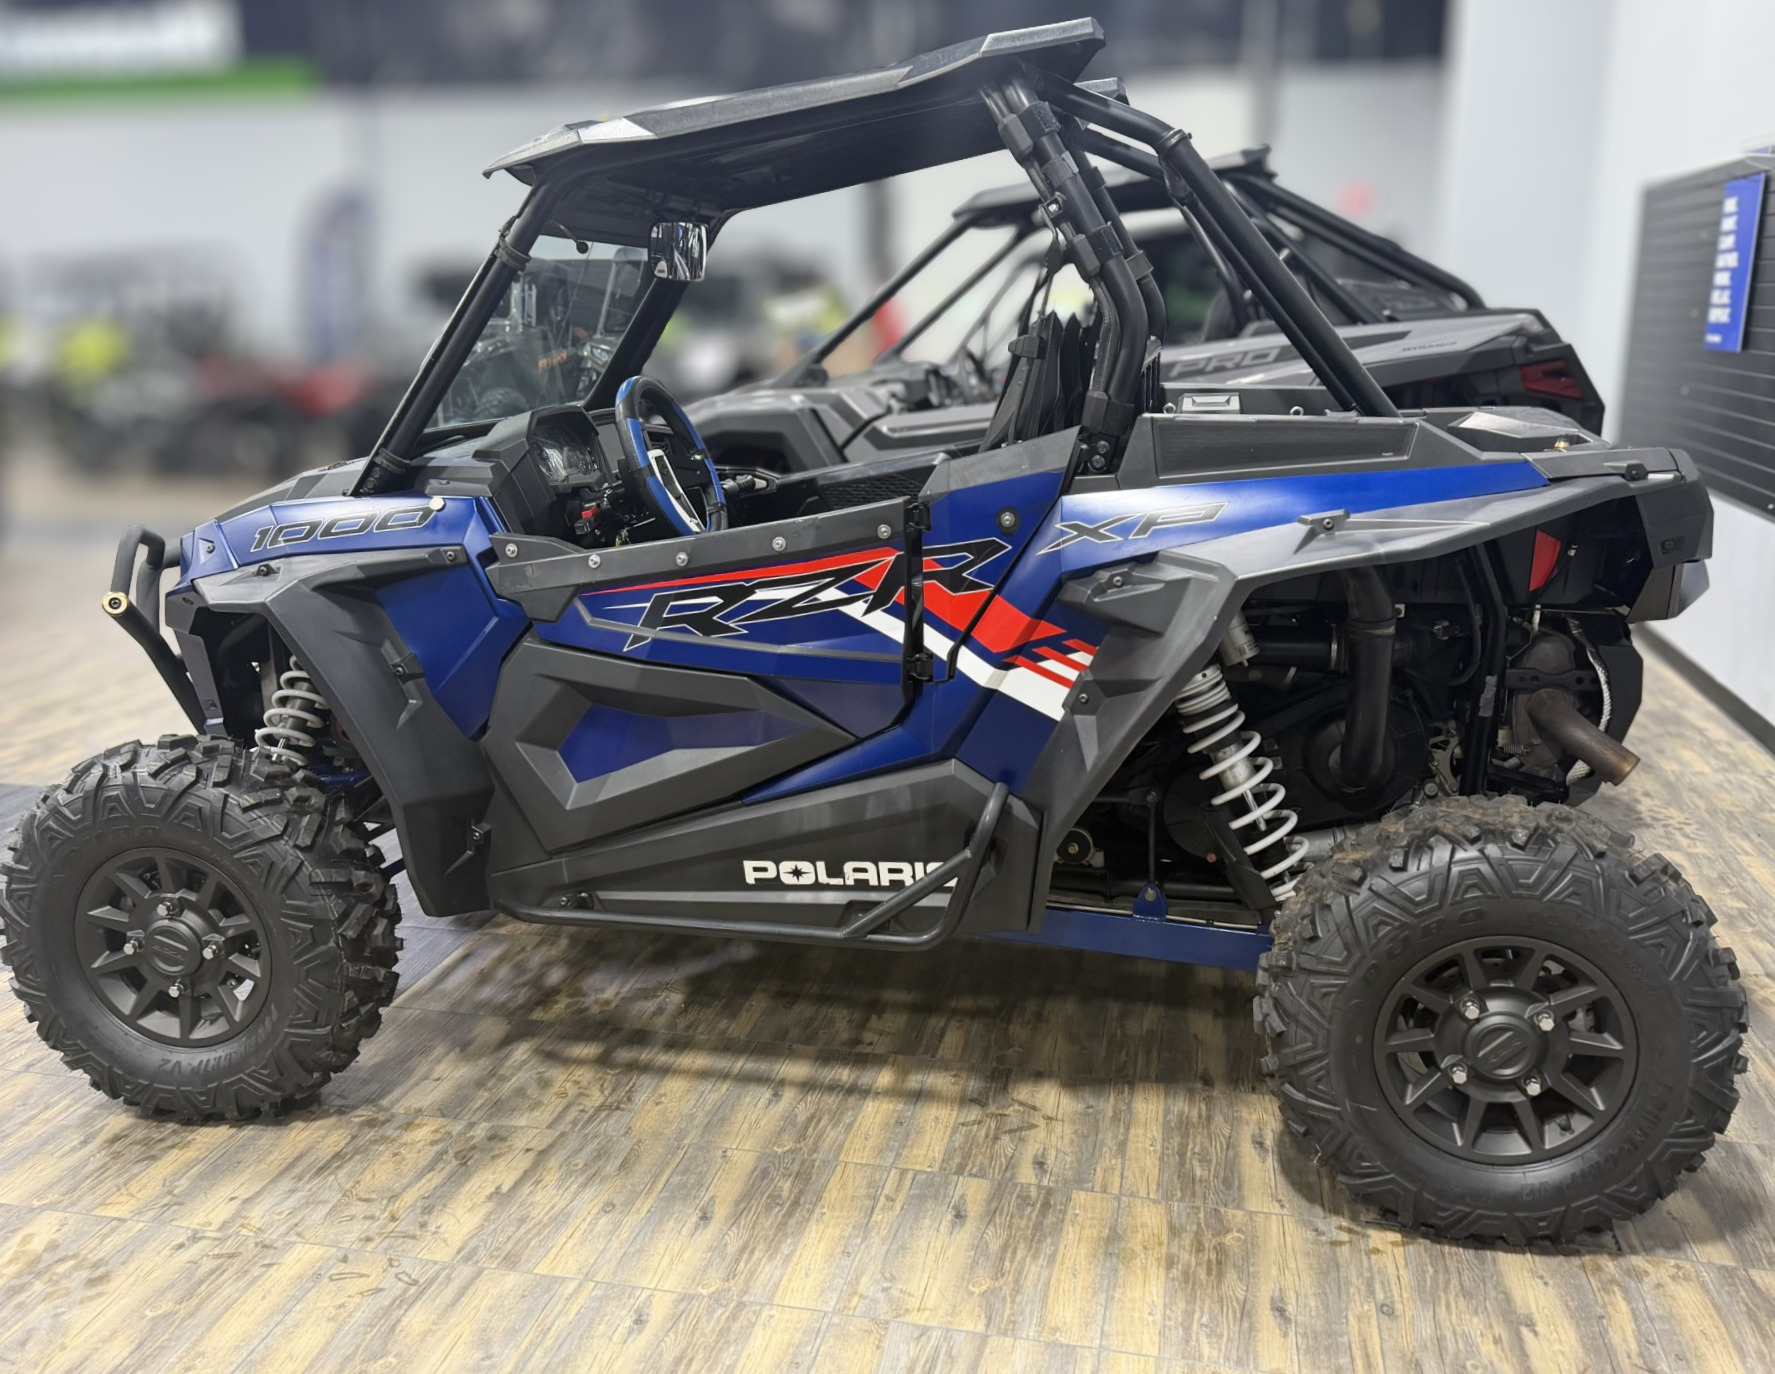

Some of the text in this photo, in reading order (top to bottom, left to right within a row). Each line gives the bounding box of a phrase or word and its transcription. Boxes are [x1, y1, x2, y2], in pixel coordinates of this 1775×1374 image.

[1168, 347, 1280, 378] PRO
[249, 505, 437, 553] 1000
[1035, 501, 1231, 556] XP
[622, 537, 1012, 652] RZR
